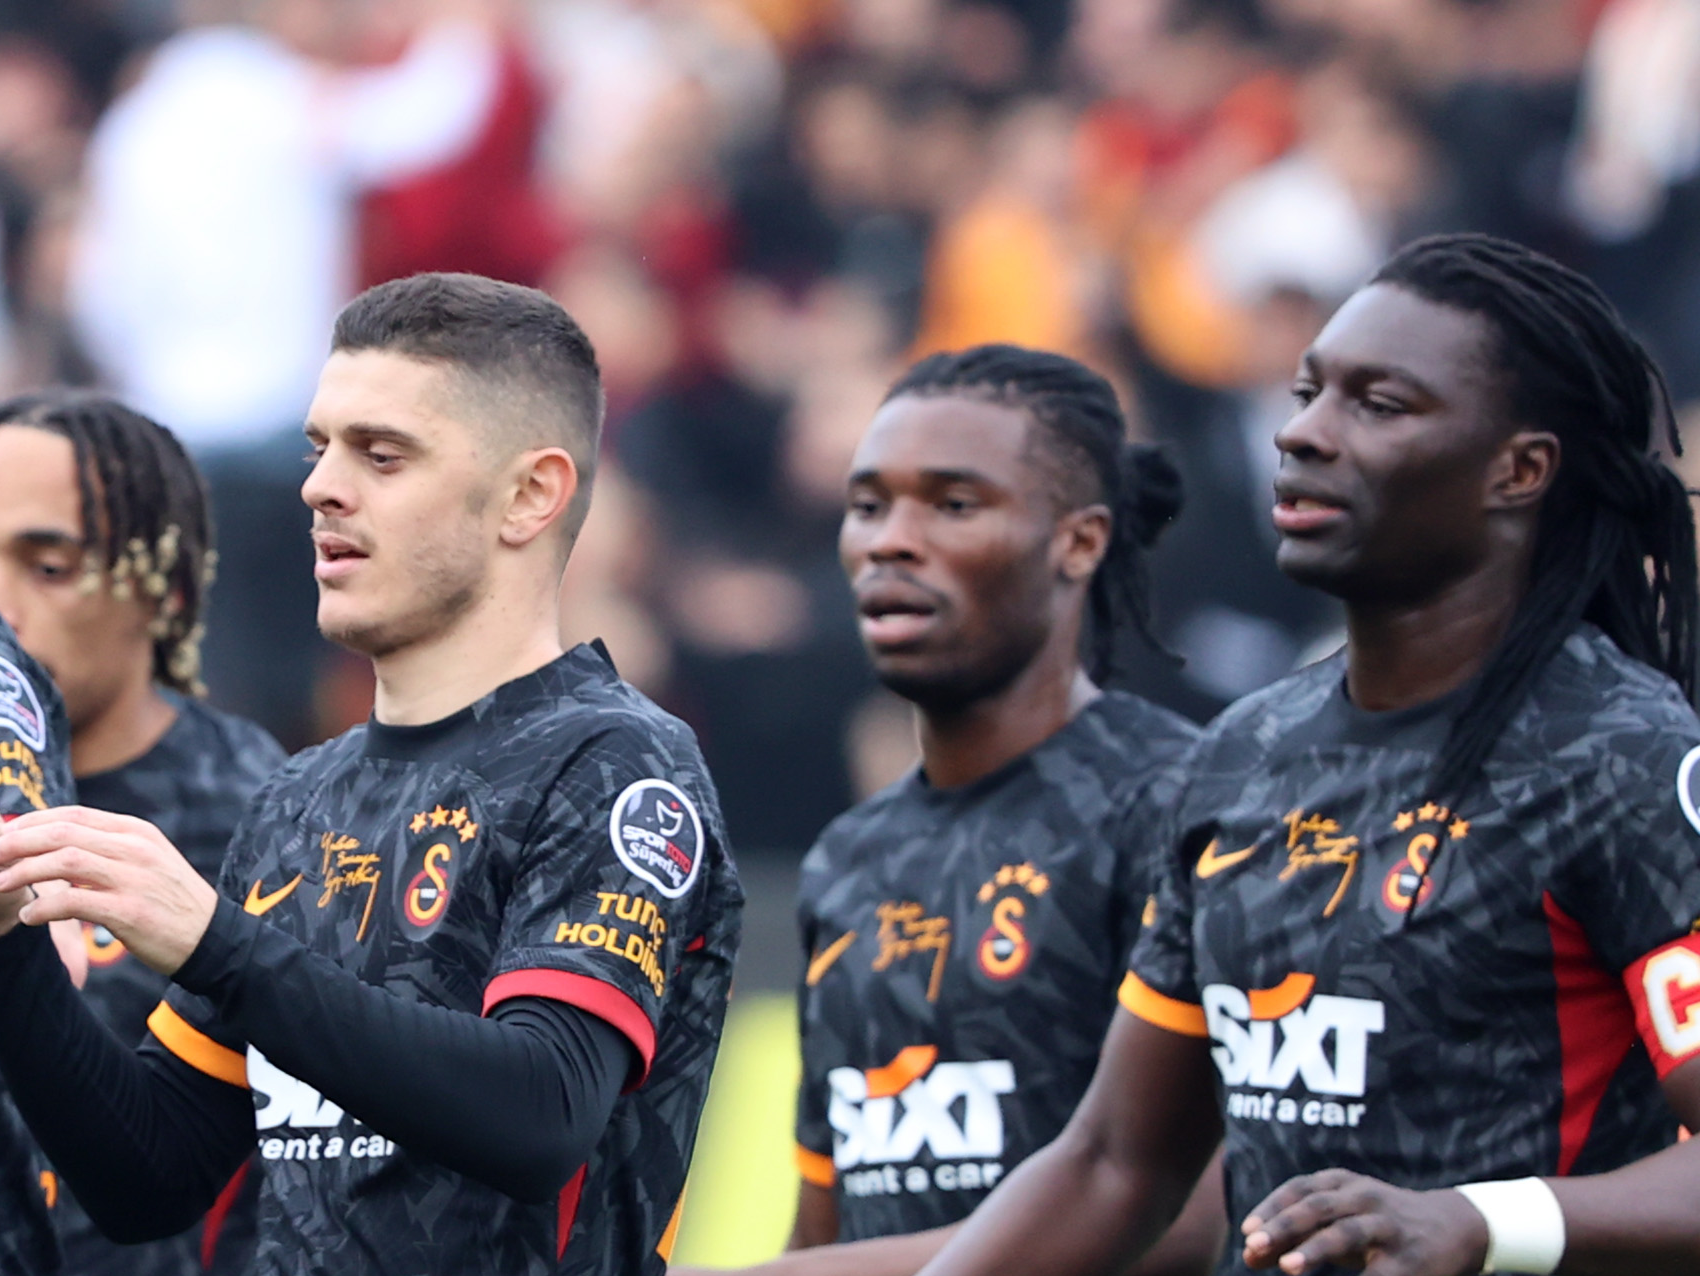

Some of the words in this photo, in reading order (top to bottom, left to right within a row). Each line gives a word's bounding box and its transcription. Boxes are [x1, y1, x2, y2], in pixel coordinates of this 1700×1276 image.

[1276, 1098, 1298, 1124] a
[1302, 1101, 1367, 1128] car
[257, 1133, 322, 1161] ent
[323, 1136, 345, 1159] a
